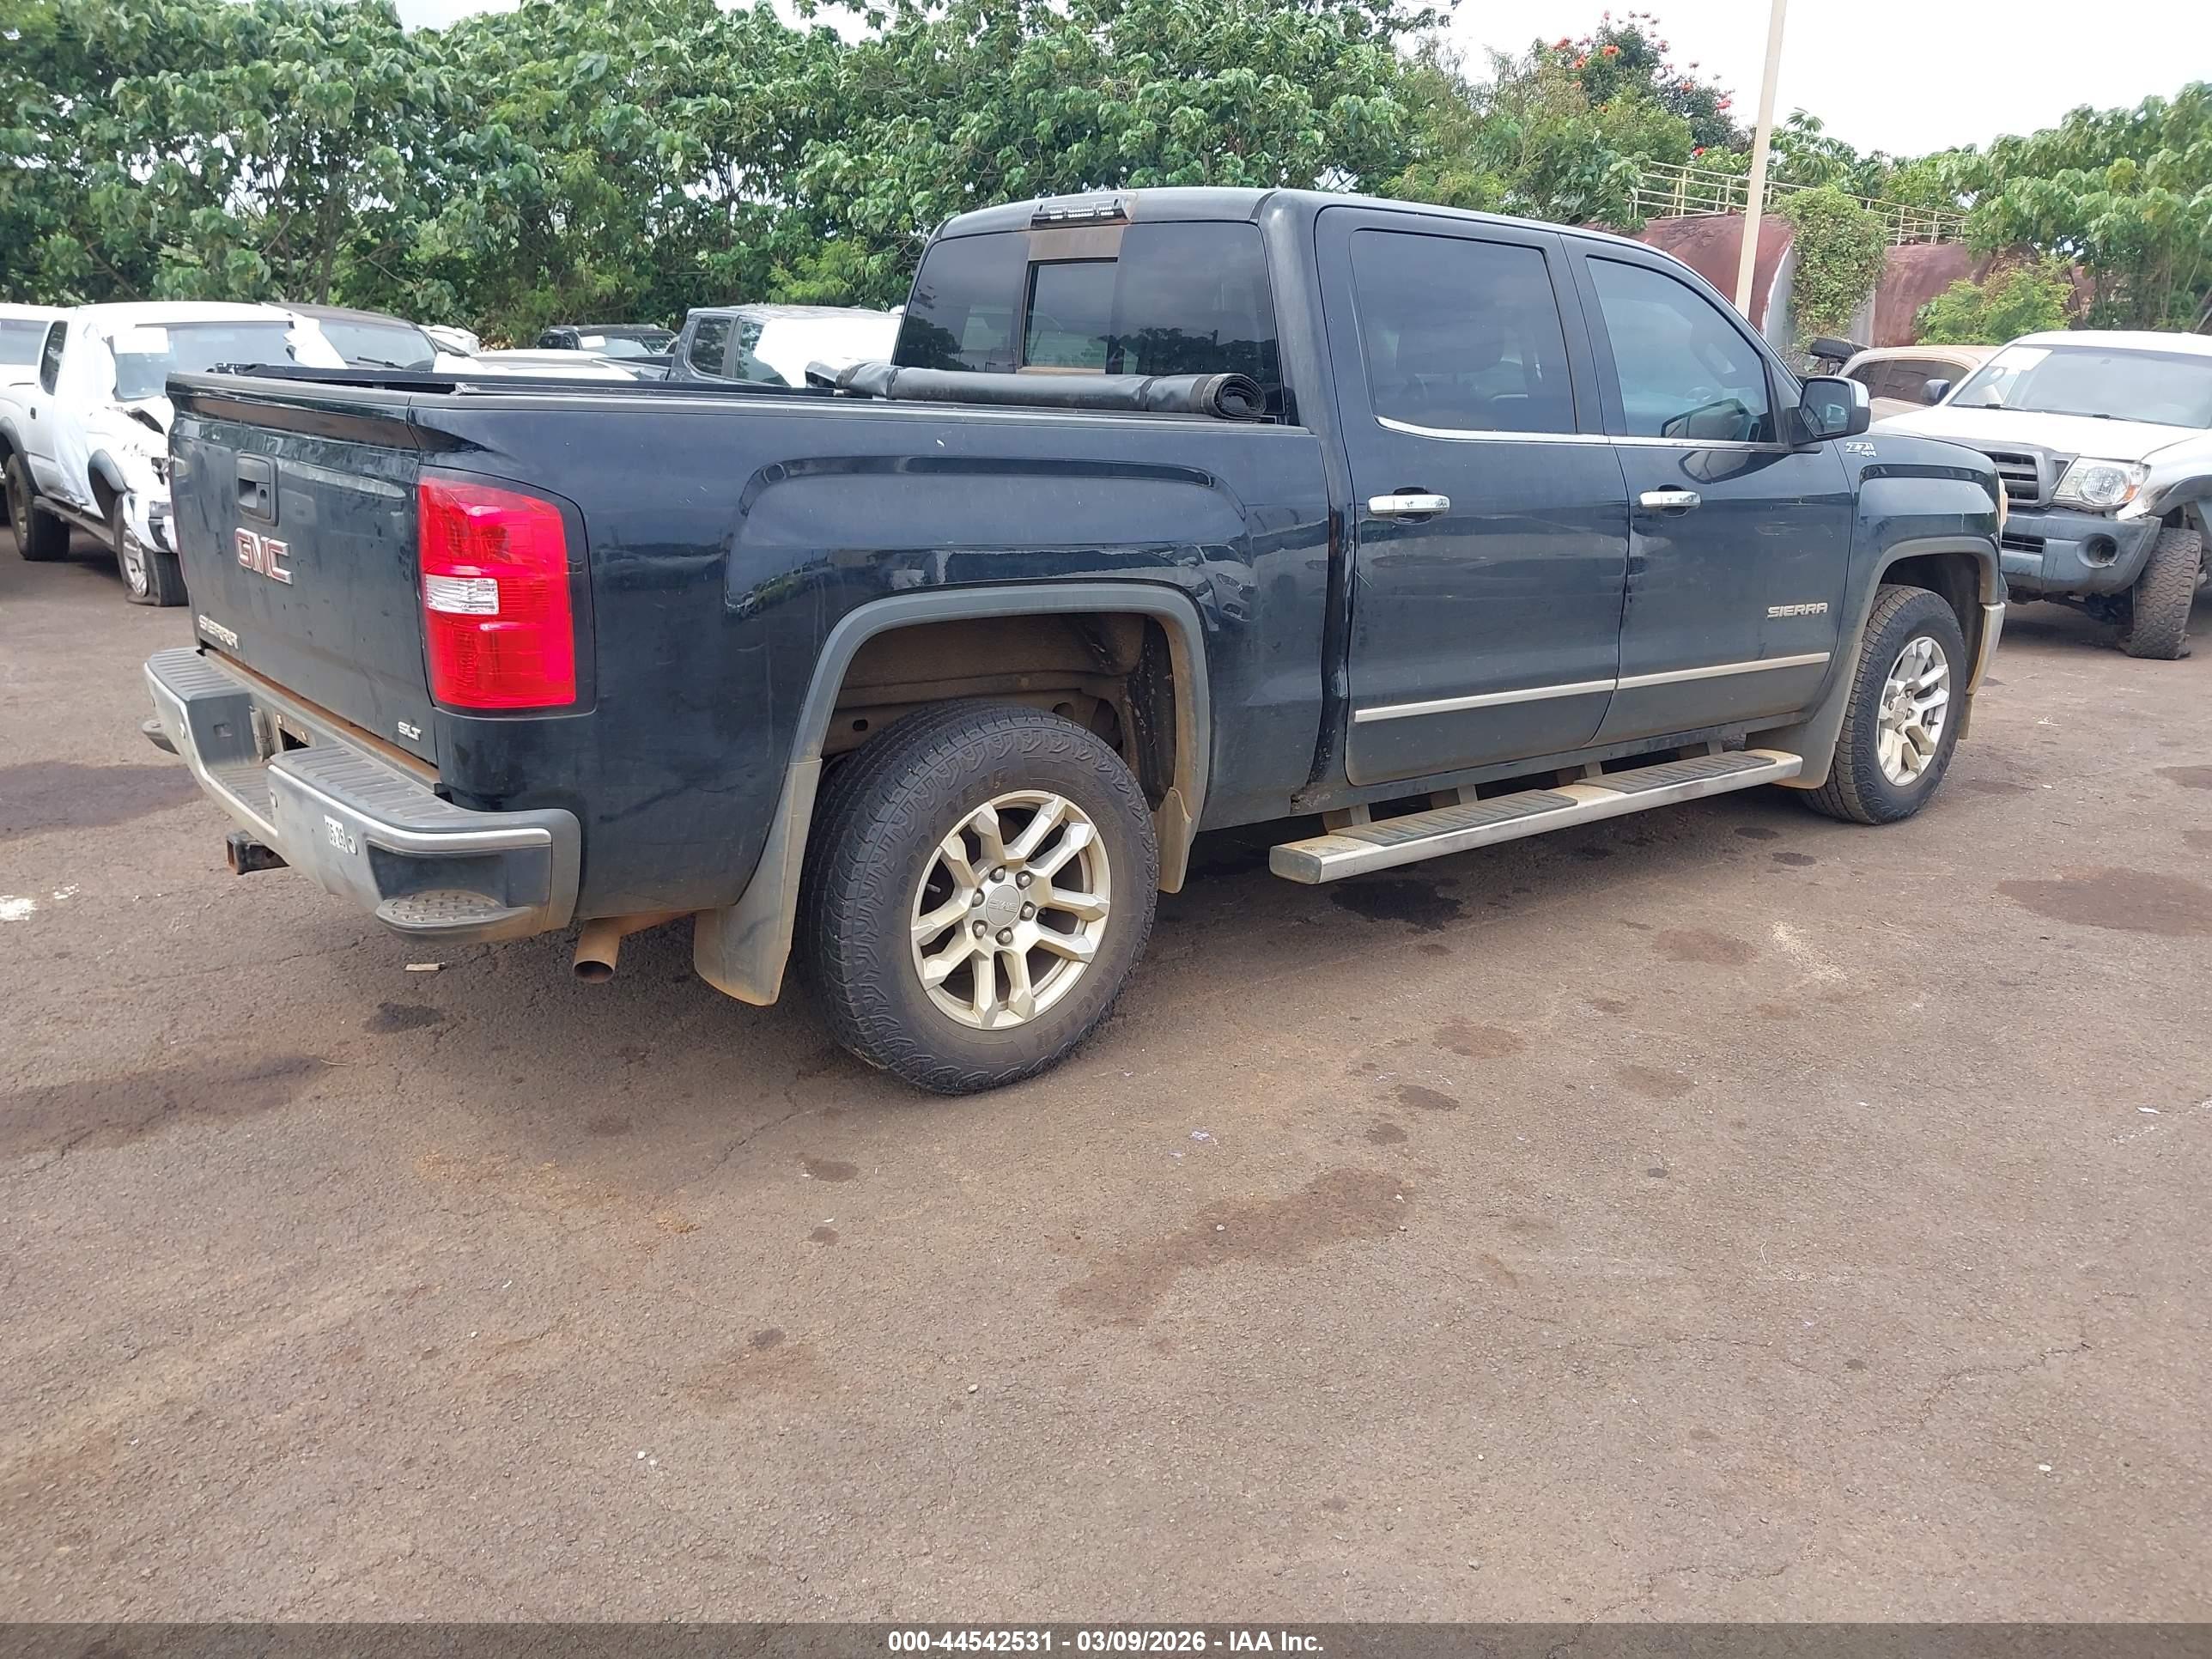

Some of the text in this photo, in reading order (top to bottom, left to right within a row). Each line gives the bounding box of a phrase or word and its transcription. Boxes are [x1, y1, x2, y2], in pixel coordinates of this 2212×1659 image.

[234, 527, 294, 585] GMC
[1767, 602, 1828, 618] SIERRA
[198, 614, 239, 649] SIERRA
[398, 721, 421, 741] SLT
